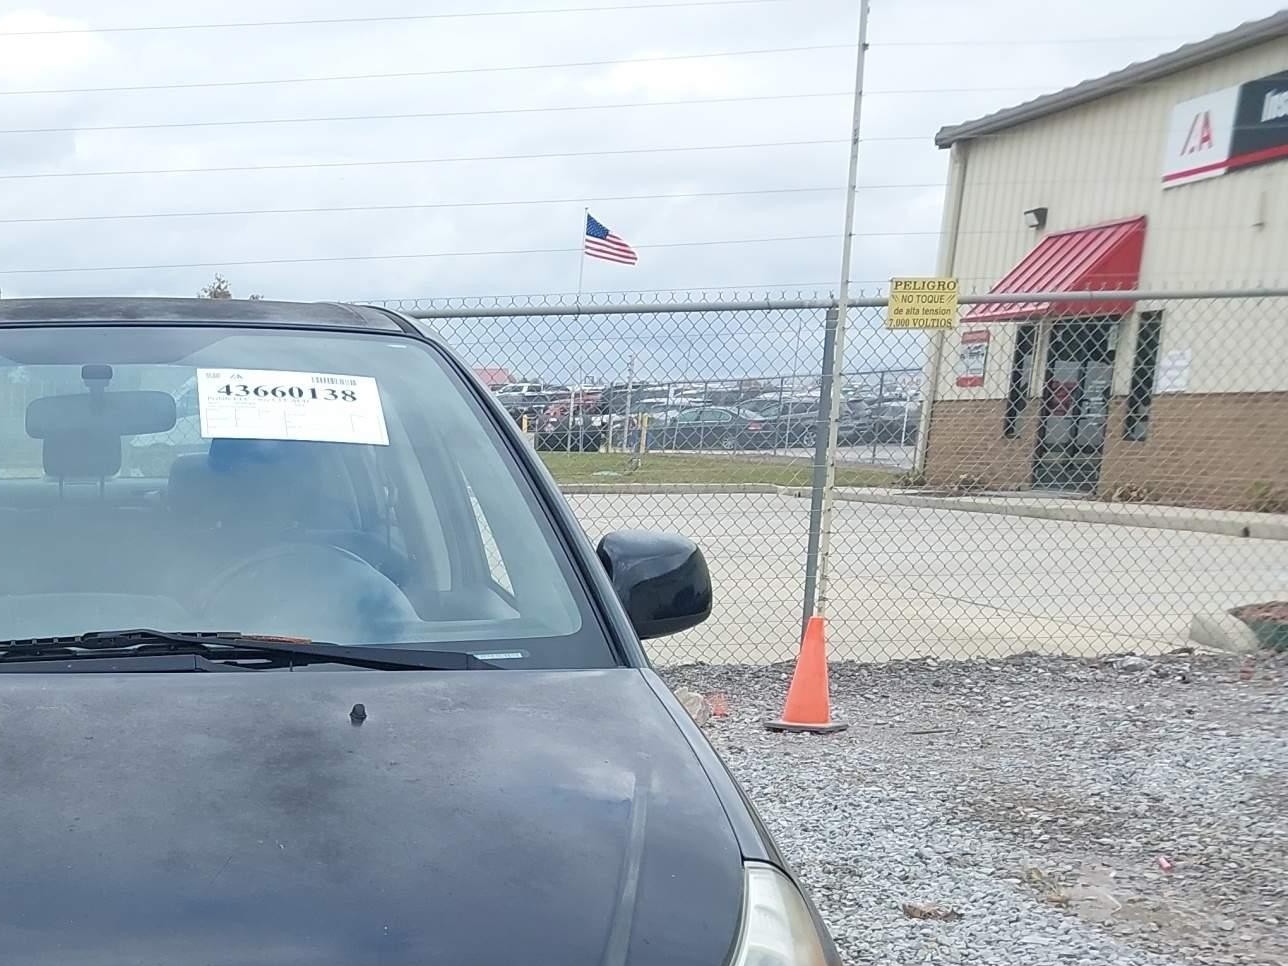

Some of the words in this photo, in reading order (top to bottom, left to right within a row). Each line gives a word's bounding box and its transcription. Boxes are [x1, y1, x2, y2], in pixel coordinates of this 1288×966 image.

[894, 281, 957, 291] PELIGRO
[901, 294, 914, 304] NO
[916, 294, 945, 304] TOQUE
[893, 307, 903, 315] de
[906, 307, 920, 315] alta
[912, 318, 952, 328] VOLTIOS
[217, 383, 357, 402] 43660138
